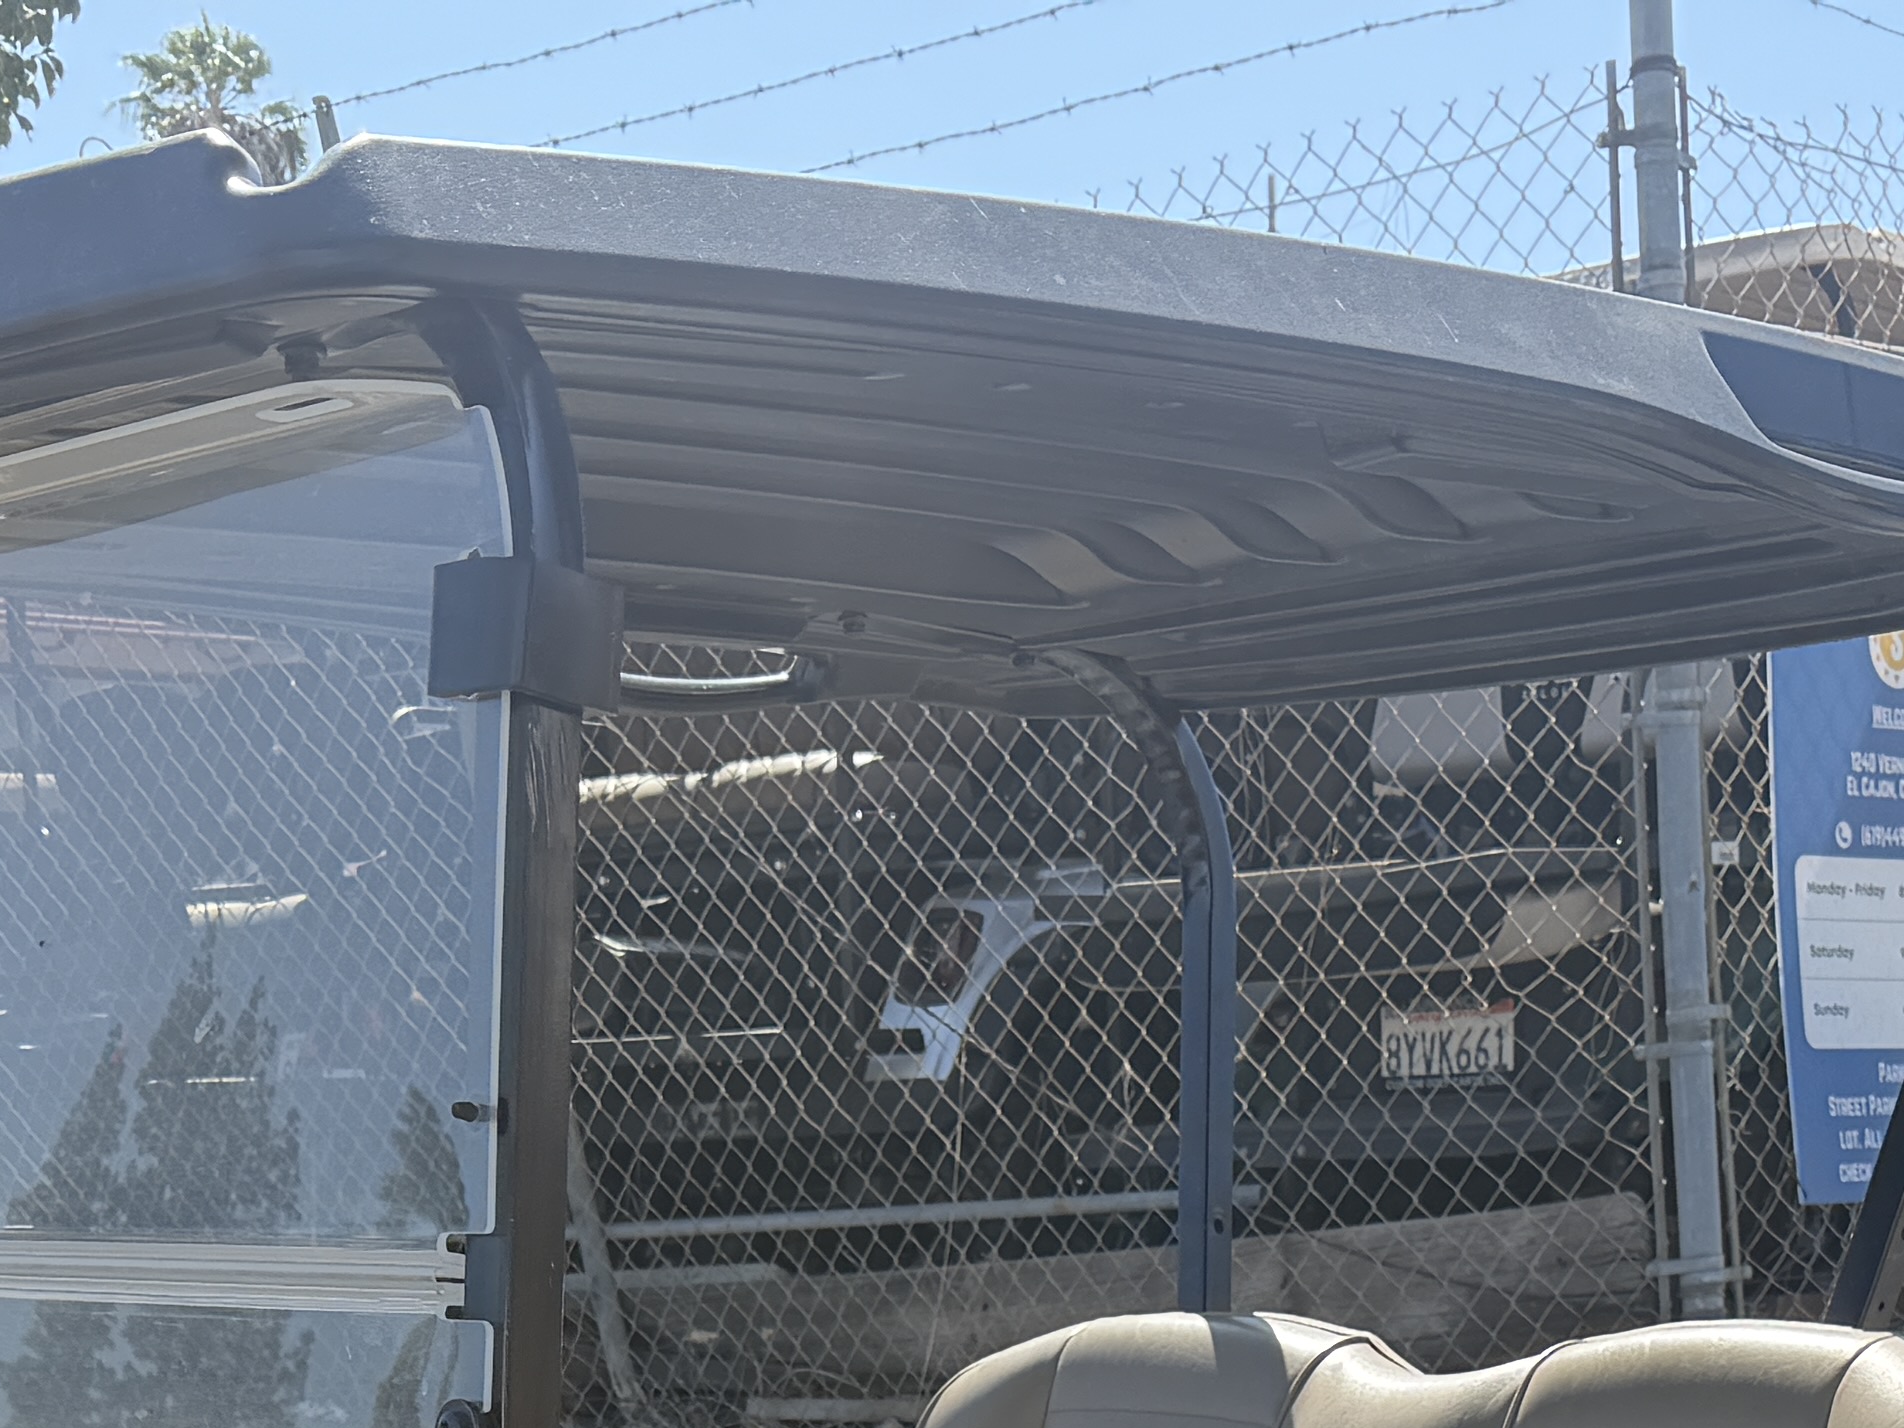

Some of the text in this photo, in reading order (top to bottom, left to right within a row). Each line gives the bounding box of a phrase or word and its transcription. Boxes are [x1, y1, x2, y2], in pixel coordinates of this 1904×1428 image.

[1851, 751, 1876, 773] 1240
[1847, 776, 1860, 797] EL
[1807, 881, 1847, 898] Monday
[1854, 882, 1886, 900] Friday
[1809, 944, 1854, 961] Saturday
[1813, 1002, 1849, 1019] Sunday
[1386, 1026, 1508, 1077] 8YVK661
[1828, 1094, 1867, 1117] STREET
